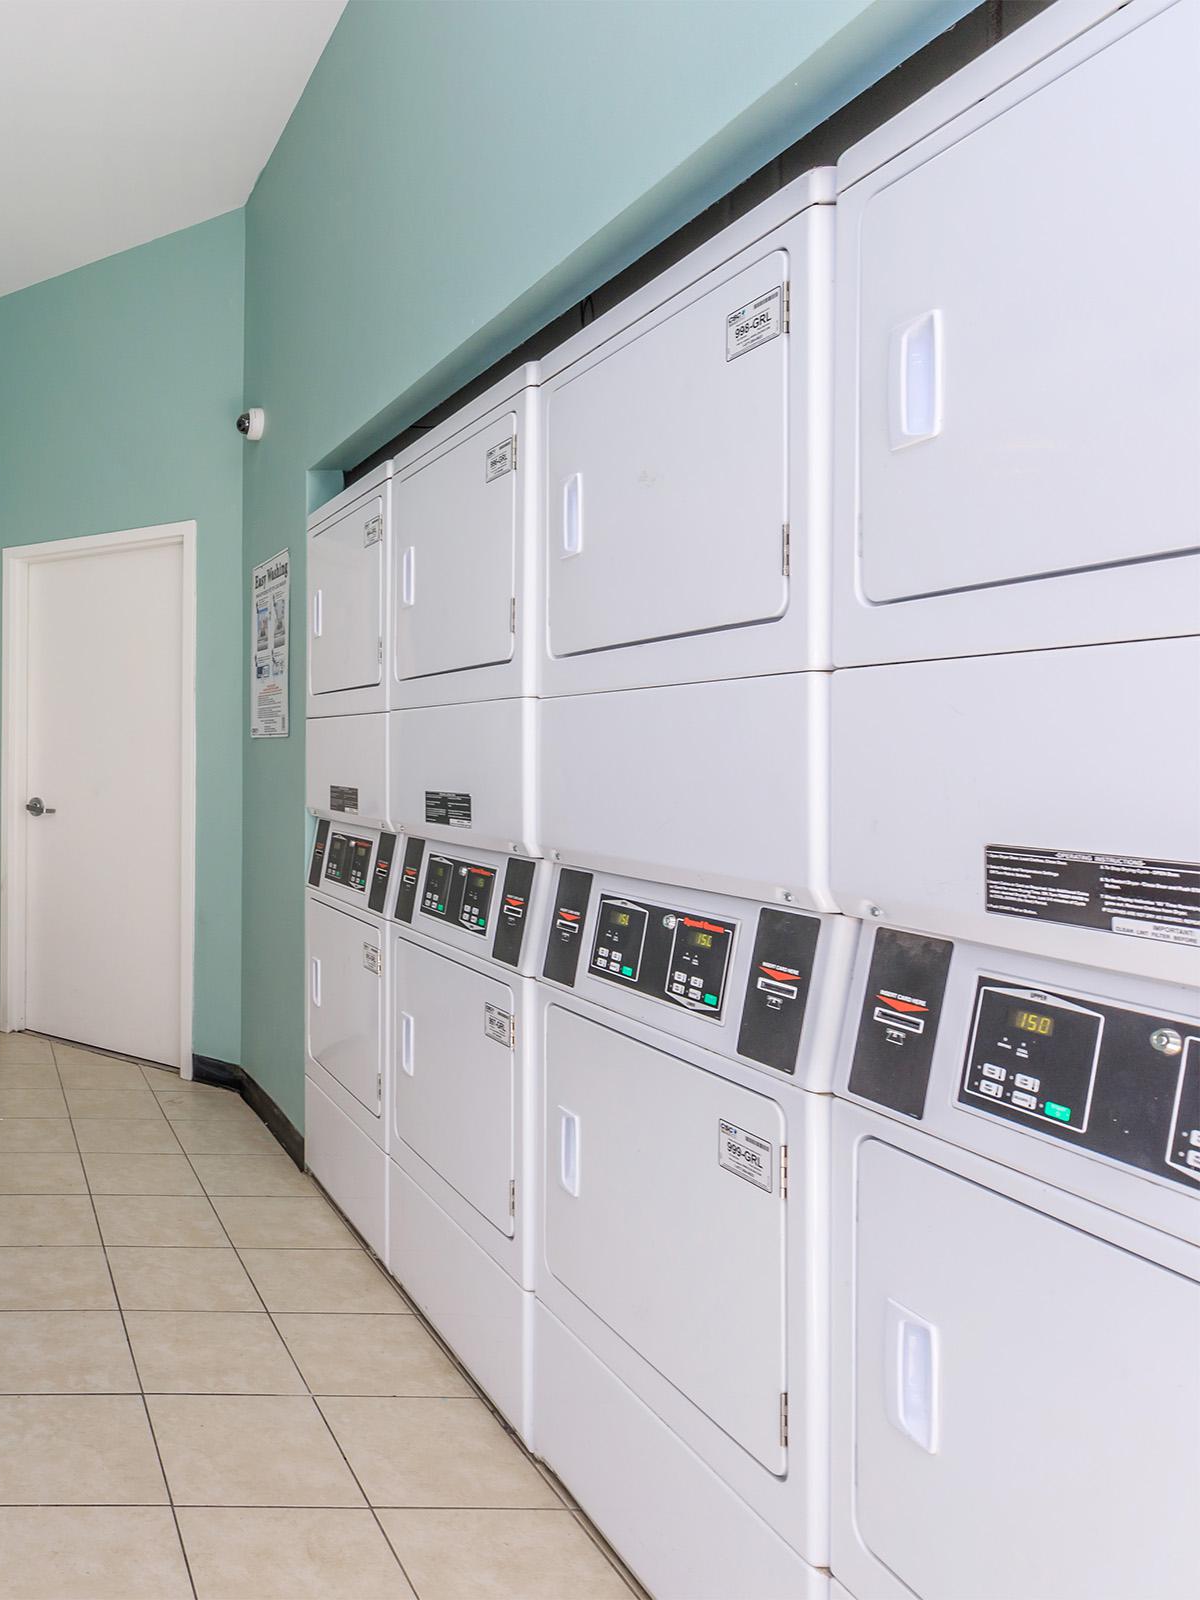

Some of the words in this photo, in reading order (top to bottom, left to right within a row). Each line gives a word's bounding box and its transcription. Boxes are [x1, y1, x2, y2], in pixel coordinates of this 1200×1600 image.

[255, 575, 267, 590] Easy
[267, 562, 289, 581] Washing
[1020, 1012, 1051, 1035] 150
[727, 1141, 764, 1170] 999-GRL
